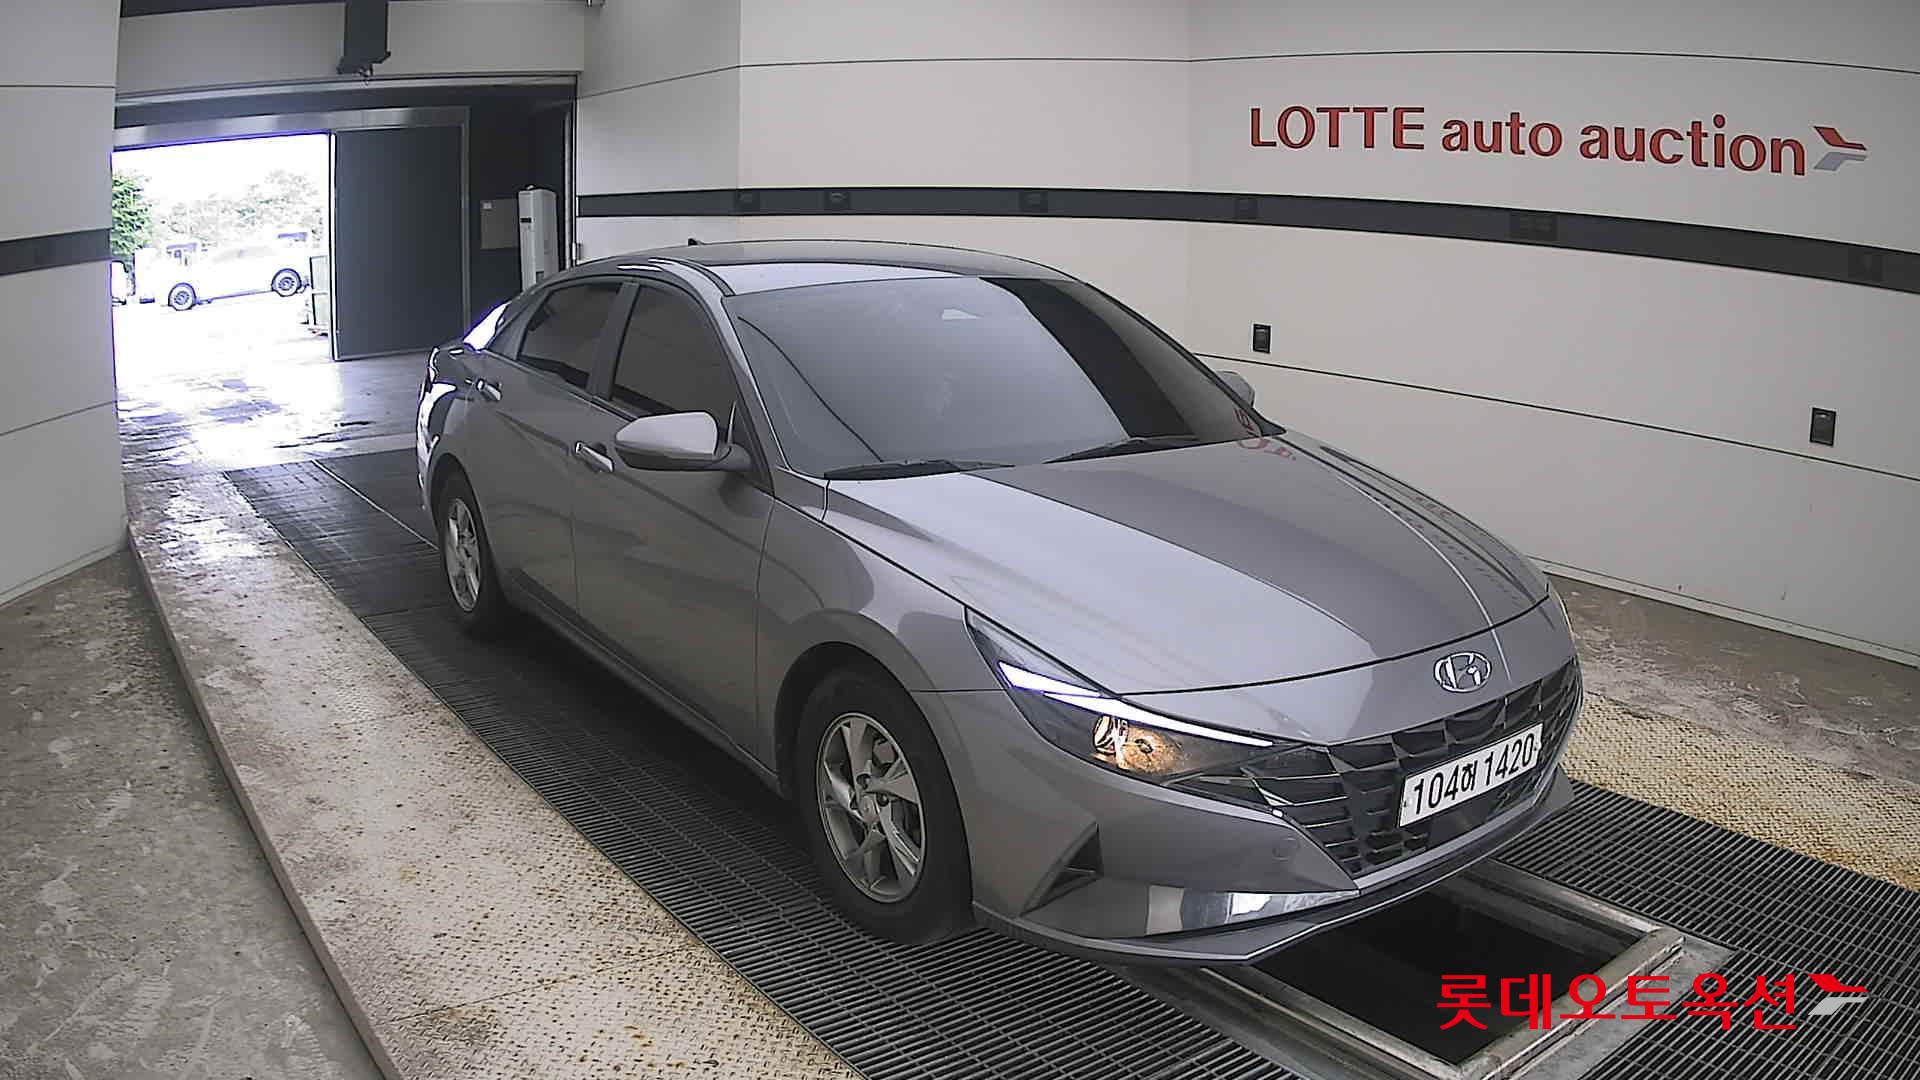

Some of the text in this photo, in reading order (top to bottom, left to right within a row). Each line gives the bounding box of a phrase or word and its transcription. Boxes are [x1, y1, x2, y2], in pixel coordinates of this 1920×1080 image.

[1249, 106, 1806, 176] LOTTE auto auction
[1485, 733, 1535, 786] 1420
